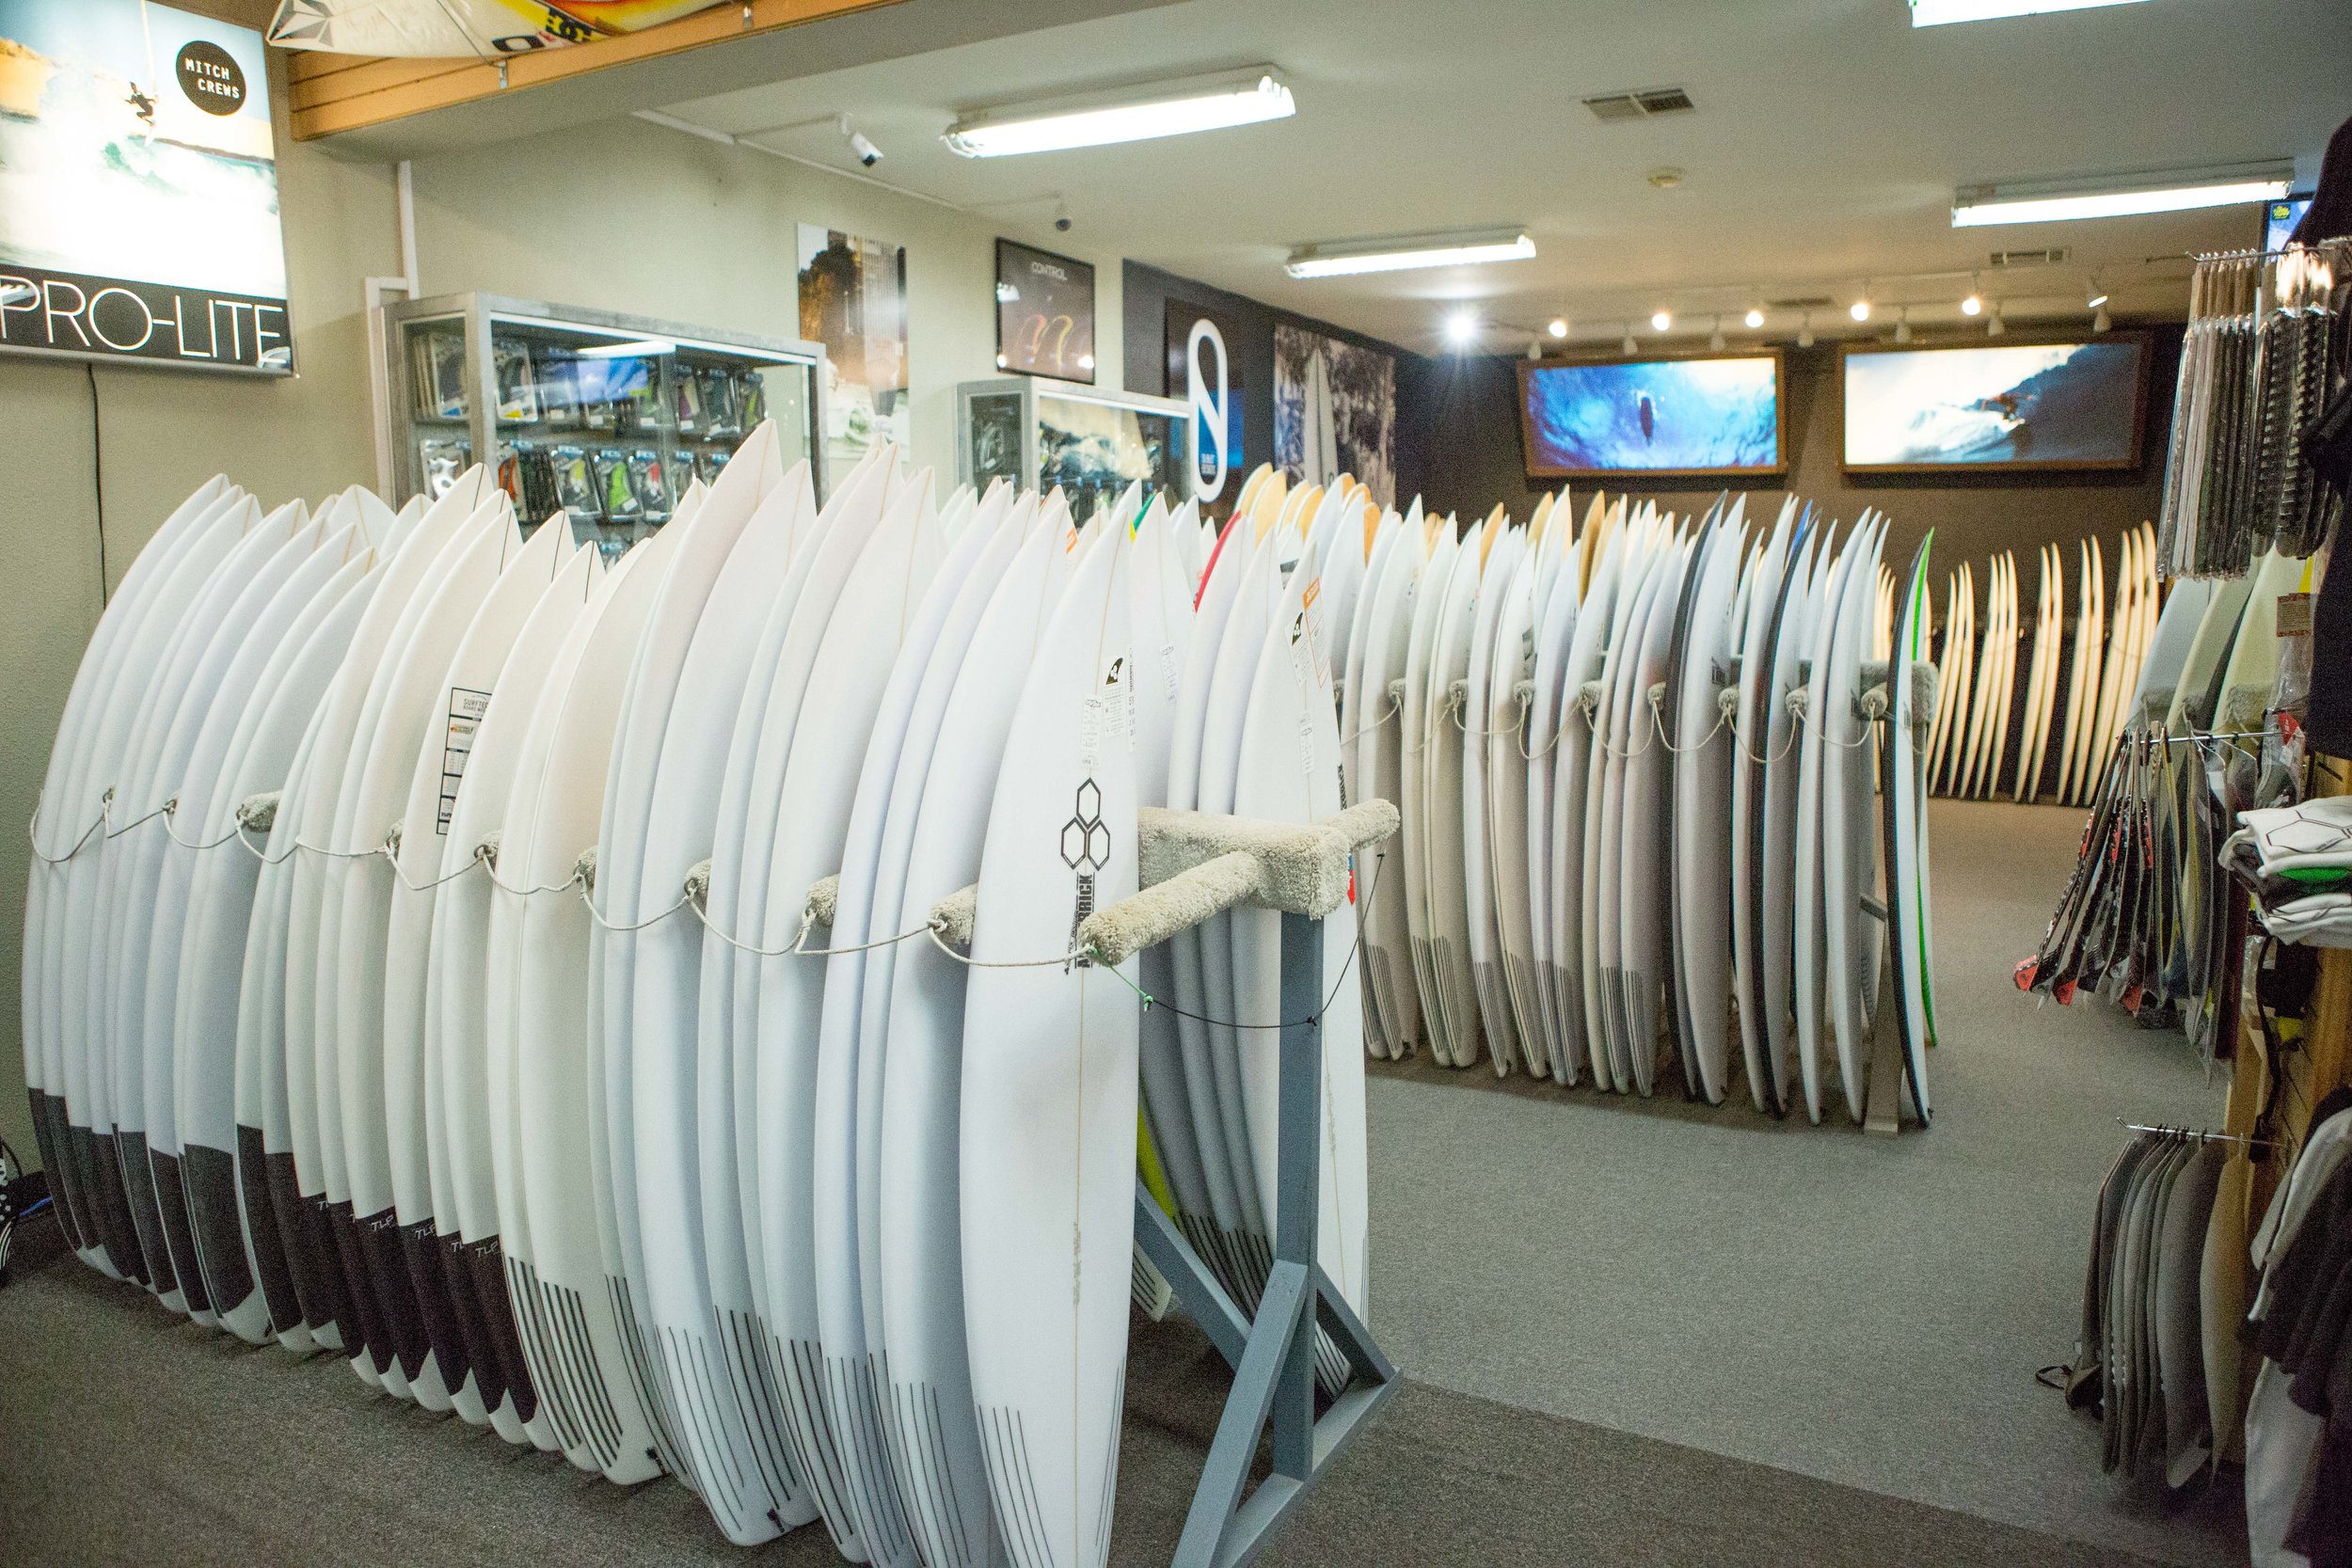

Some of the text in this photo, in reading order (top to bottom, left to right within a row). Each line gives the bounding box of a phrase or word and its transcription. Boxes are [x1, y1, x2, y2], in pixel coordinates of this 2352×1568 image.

[184, 57, 230, 80] MITCH
[197, 77, 240, 100] CREWS
[1031, 261, 1068, 281] CONTROL
[0, 274, 287, 368] PRO-LITE
